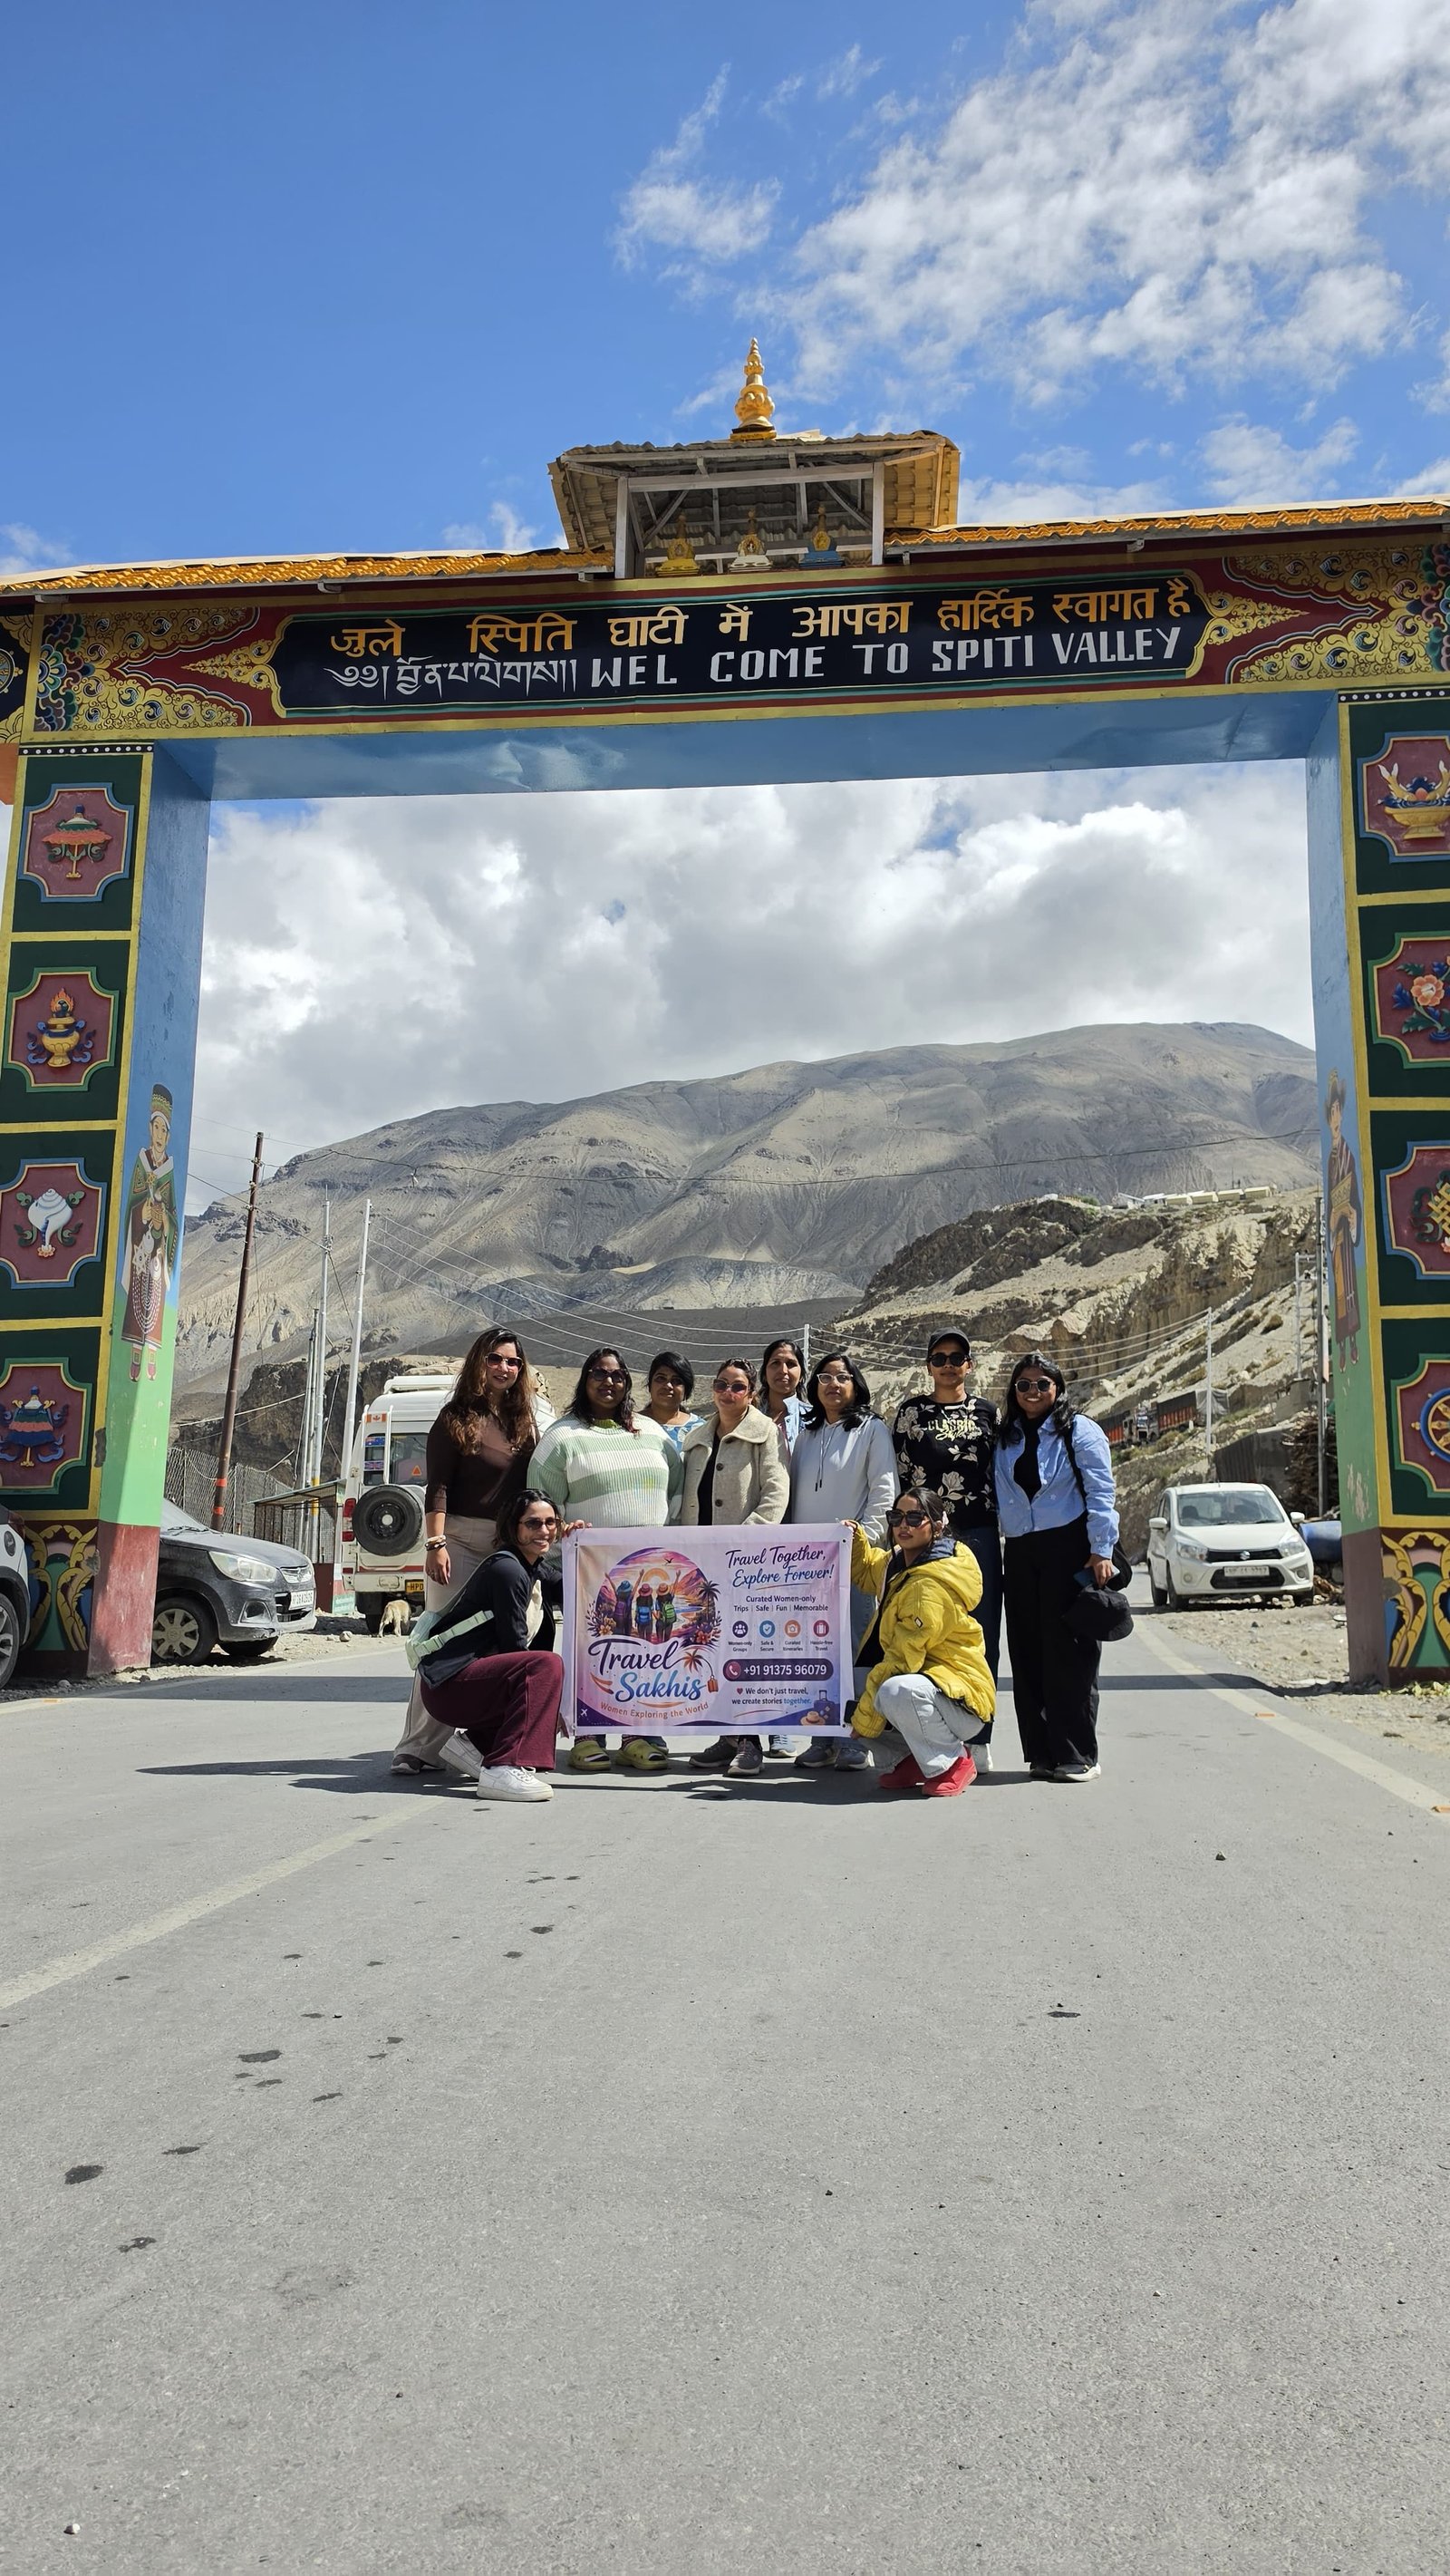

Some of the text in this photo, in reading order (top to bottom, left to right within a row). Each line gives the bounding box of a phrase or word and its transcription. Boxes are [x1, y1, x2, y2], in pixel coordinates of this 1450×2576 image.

[330, 577, 1191, 658] जुले स्पिति घाटी में आपका हार्दिक स्वागत है
[591, 625, 1182, 688] WEL COME TO SPITI VALLEY
[725, 1545, 826, 1569] Travel Together,
[732, 1564, 835, 1590] Explore Forever!
[588, 1638, 683, 1676] Travel
[744, 1664, 827, 1676] +91 91375 96079
[615, 1670, 707, 1702] Sakhis
[774, 1688, 788, 1696] just
[600, 1701, 709, 1719] Women Exploring the World
[784, 1697, 812, 1706] together.
